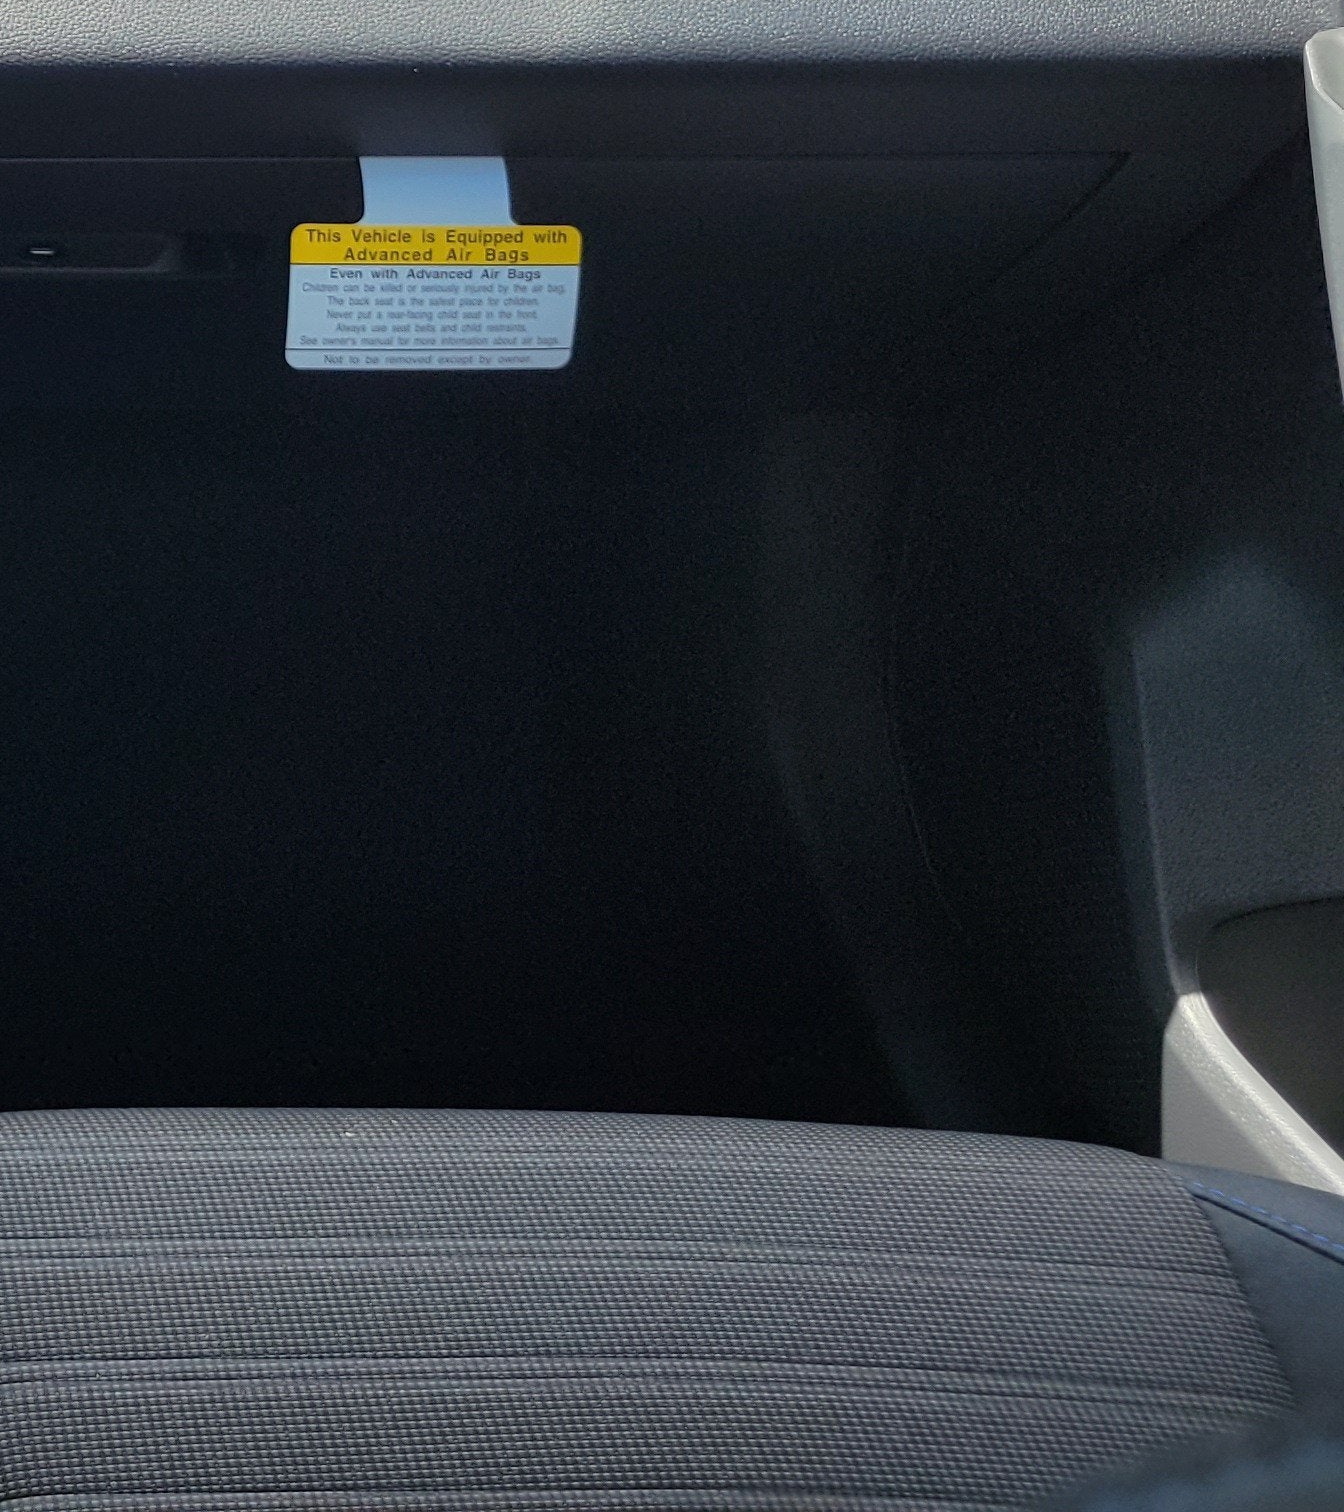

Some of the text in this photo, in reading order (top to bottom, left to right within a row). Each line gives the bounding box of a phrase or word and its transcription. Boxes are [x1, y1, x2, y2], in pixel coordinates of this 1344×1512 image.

[305, 228, 569, 247] This Vehicle is Equipped with
[344, 246, 530, 264] Advanced Air Bags
[329, 267, 542, 282] Even with Advanced Air Bags
